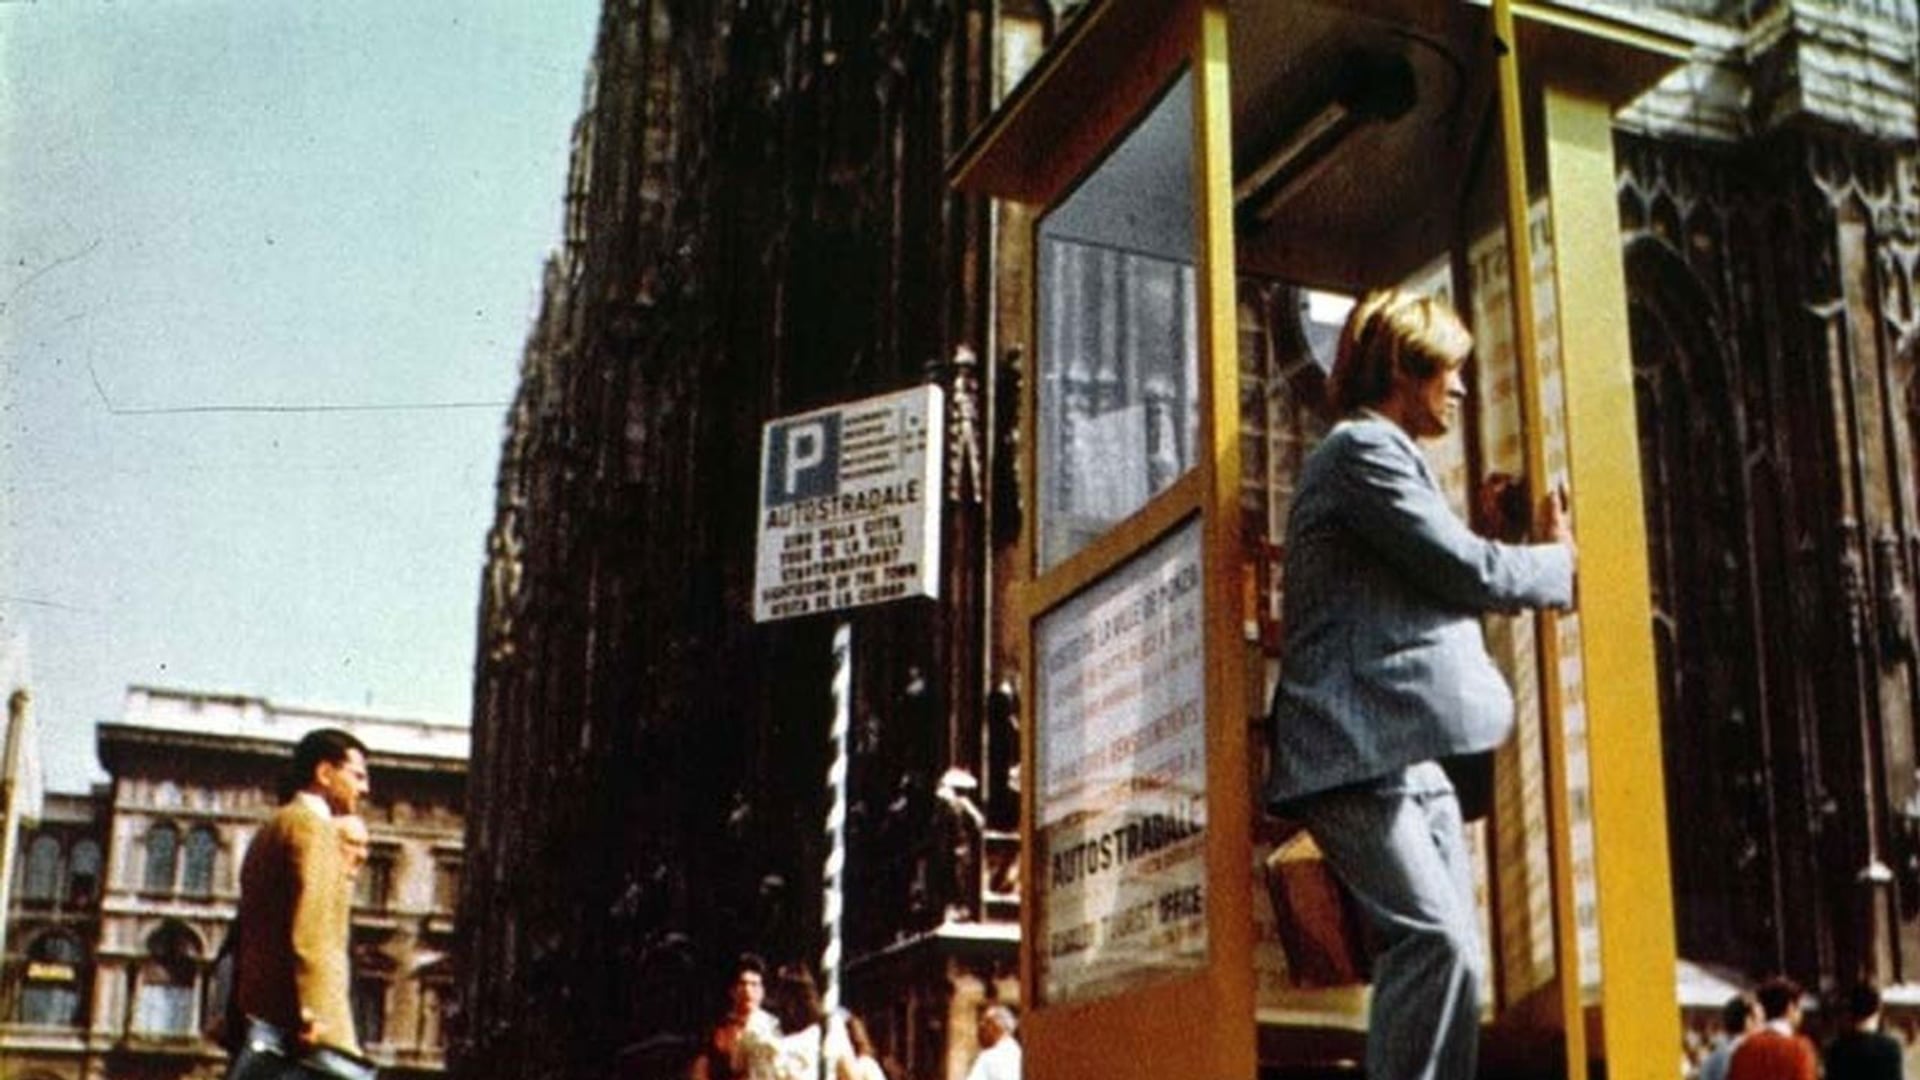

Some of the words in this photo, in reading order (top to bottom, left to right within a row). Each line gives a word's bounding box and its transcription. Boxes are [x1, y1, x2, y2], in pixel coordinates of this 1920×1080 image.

[786, 422, 824, 494] P
[767, 480, 919, 529] AUTOSTRADALE
[821, 544, 835, 558] DE
[844, 540, 859, 555] LA
[869, 530, 903, 549] VILLE
[855, 571, 876, 586] THE
[883, 563, 917, 580] TOWN
